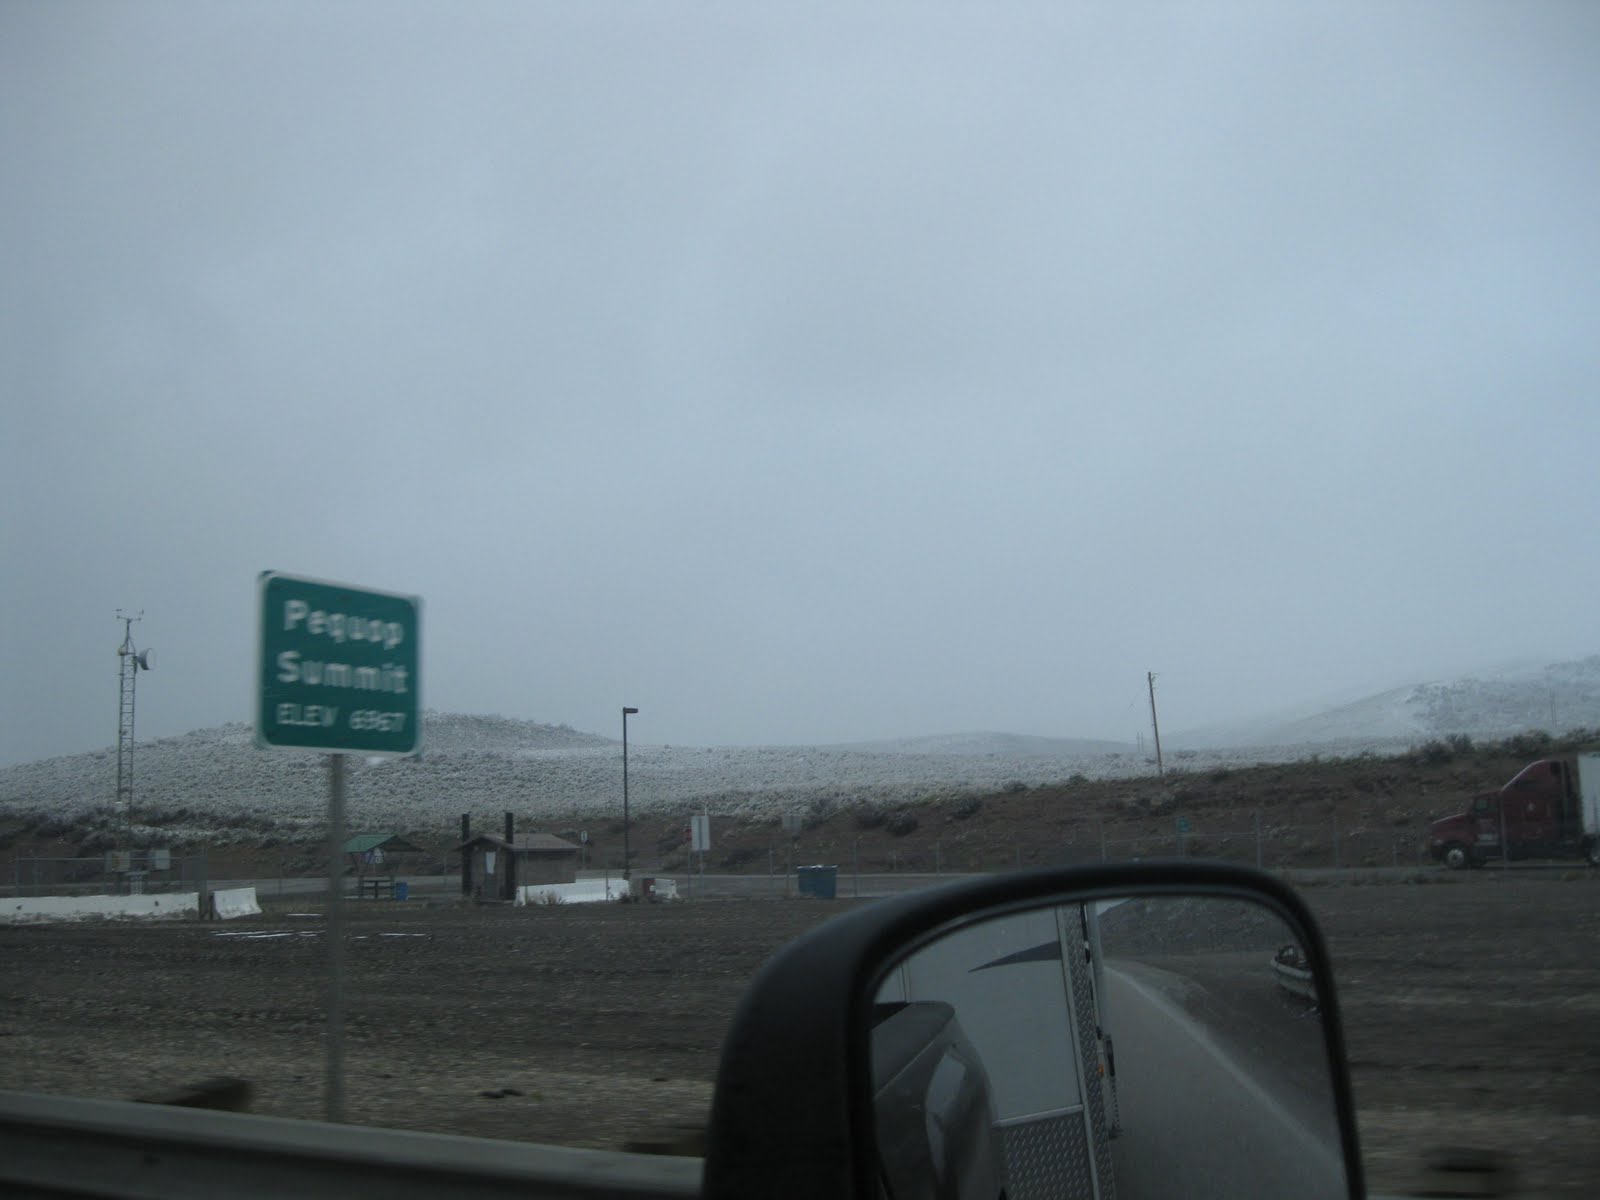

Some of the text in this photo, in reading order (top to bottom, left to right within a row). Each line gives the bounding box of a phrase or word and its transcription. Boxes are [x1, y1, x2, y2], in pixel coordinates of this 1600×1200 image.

[284, 600, 403, 650] Pequop
[277, 651, 407, 693] Summit
[277, 703, 339, 727] ELEV
